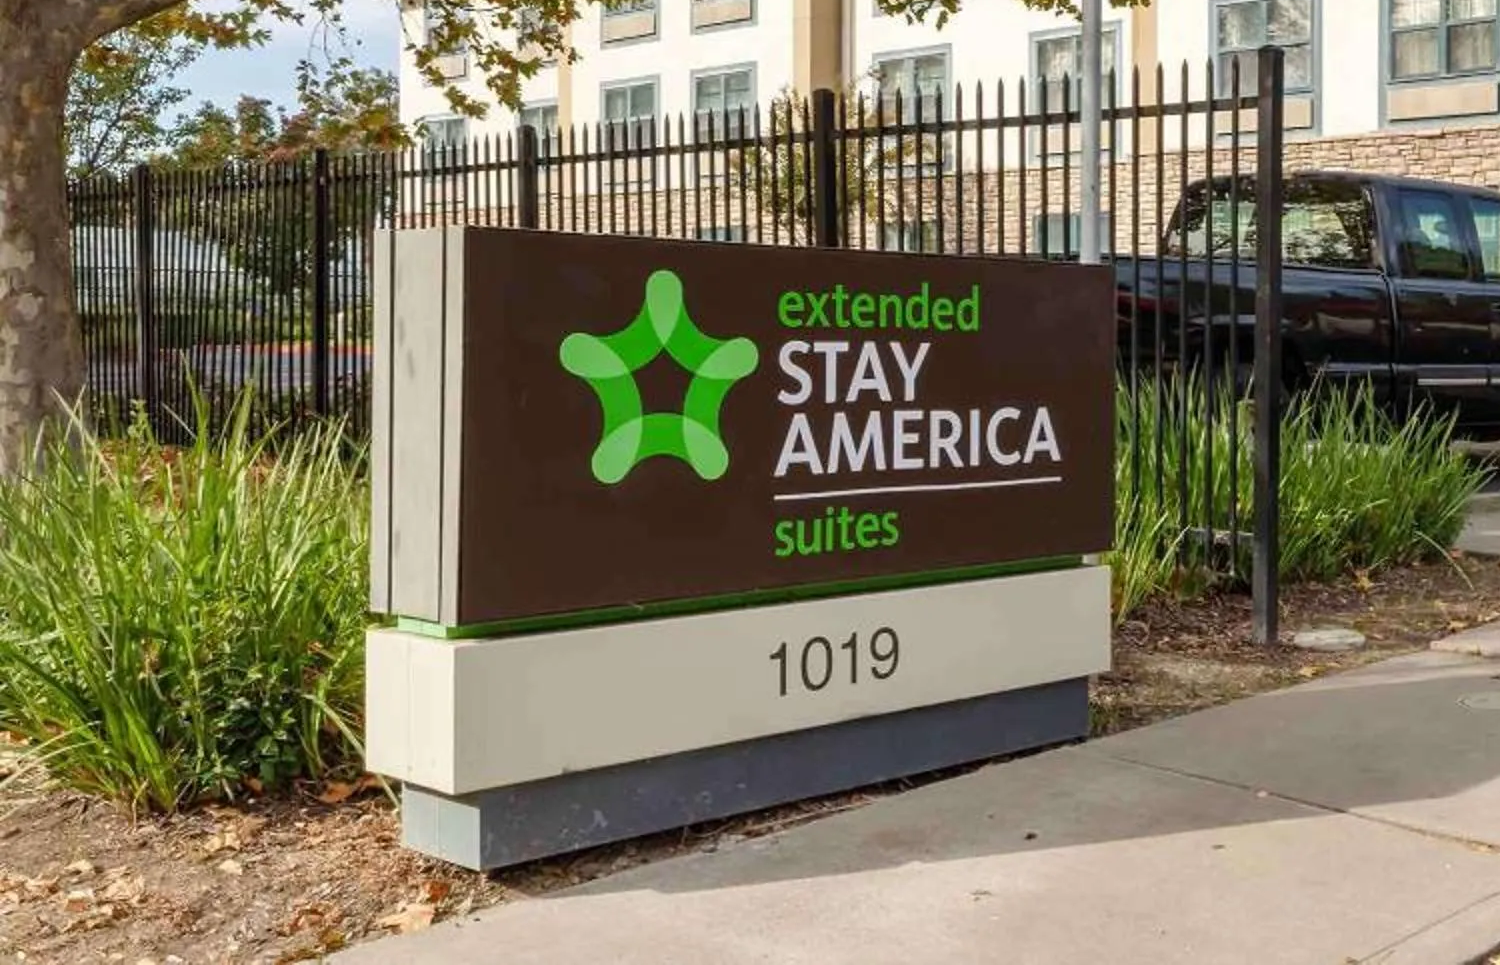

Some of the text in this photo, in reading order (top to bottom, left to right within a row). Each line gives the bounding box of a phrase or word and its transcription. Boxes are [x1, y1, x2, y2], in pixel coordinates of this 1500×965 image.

[778, 282, 980, 332] extended
[777, 340, 931, 405] STAY
[774, 407, 1061, 477] AMERICA
[774, 507, 898, 557] suites
[769, 626, 900, 696] 1019
